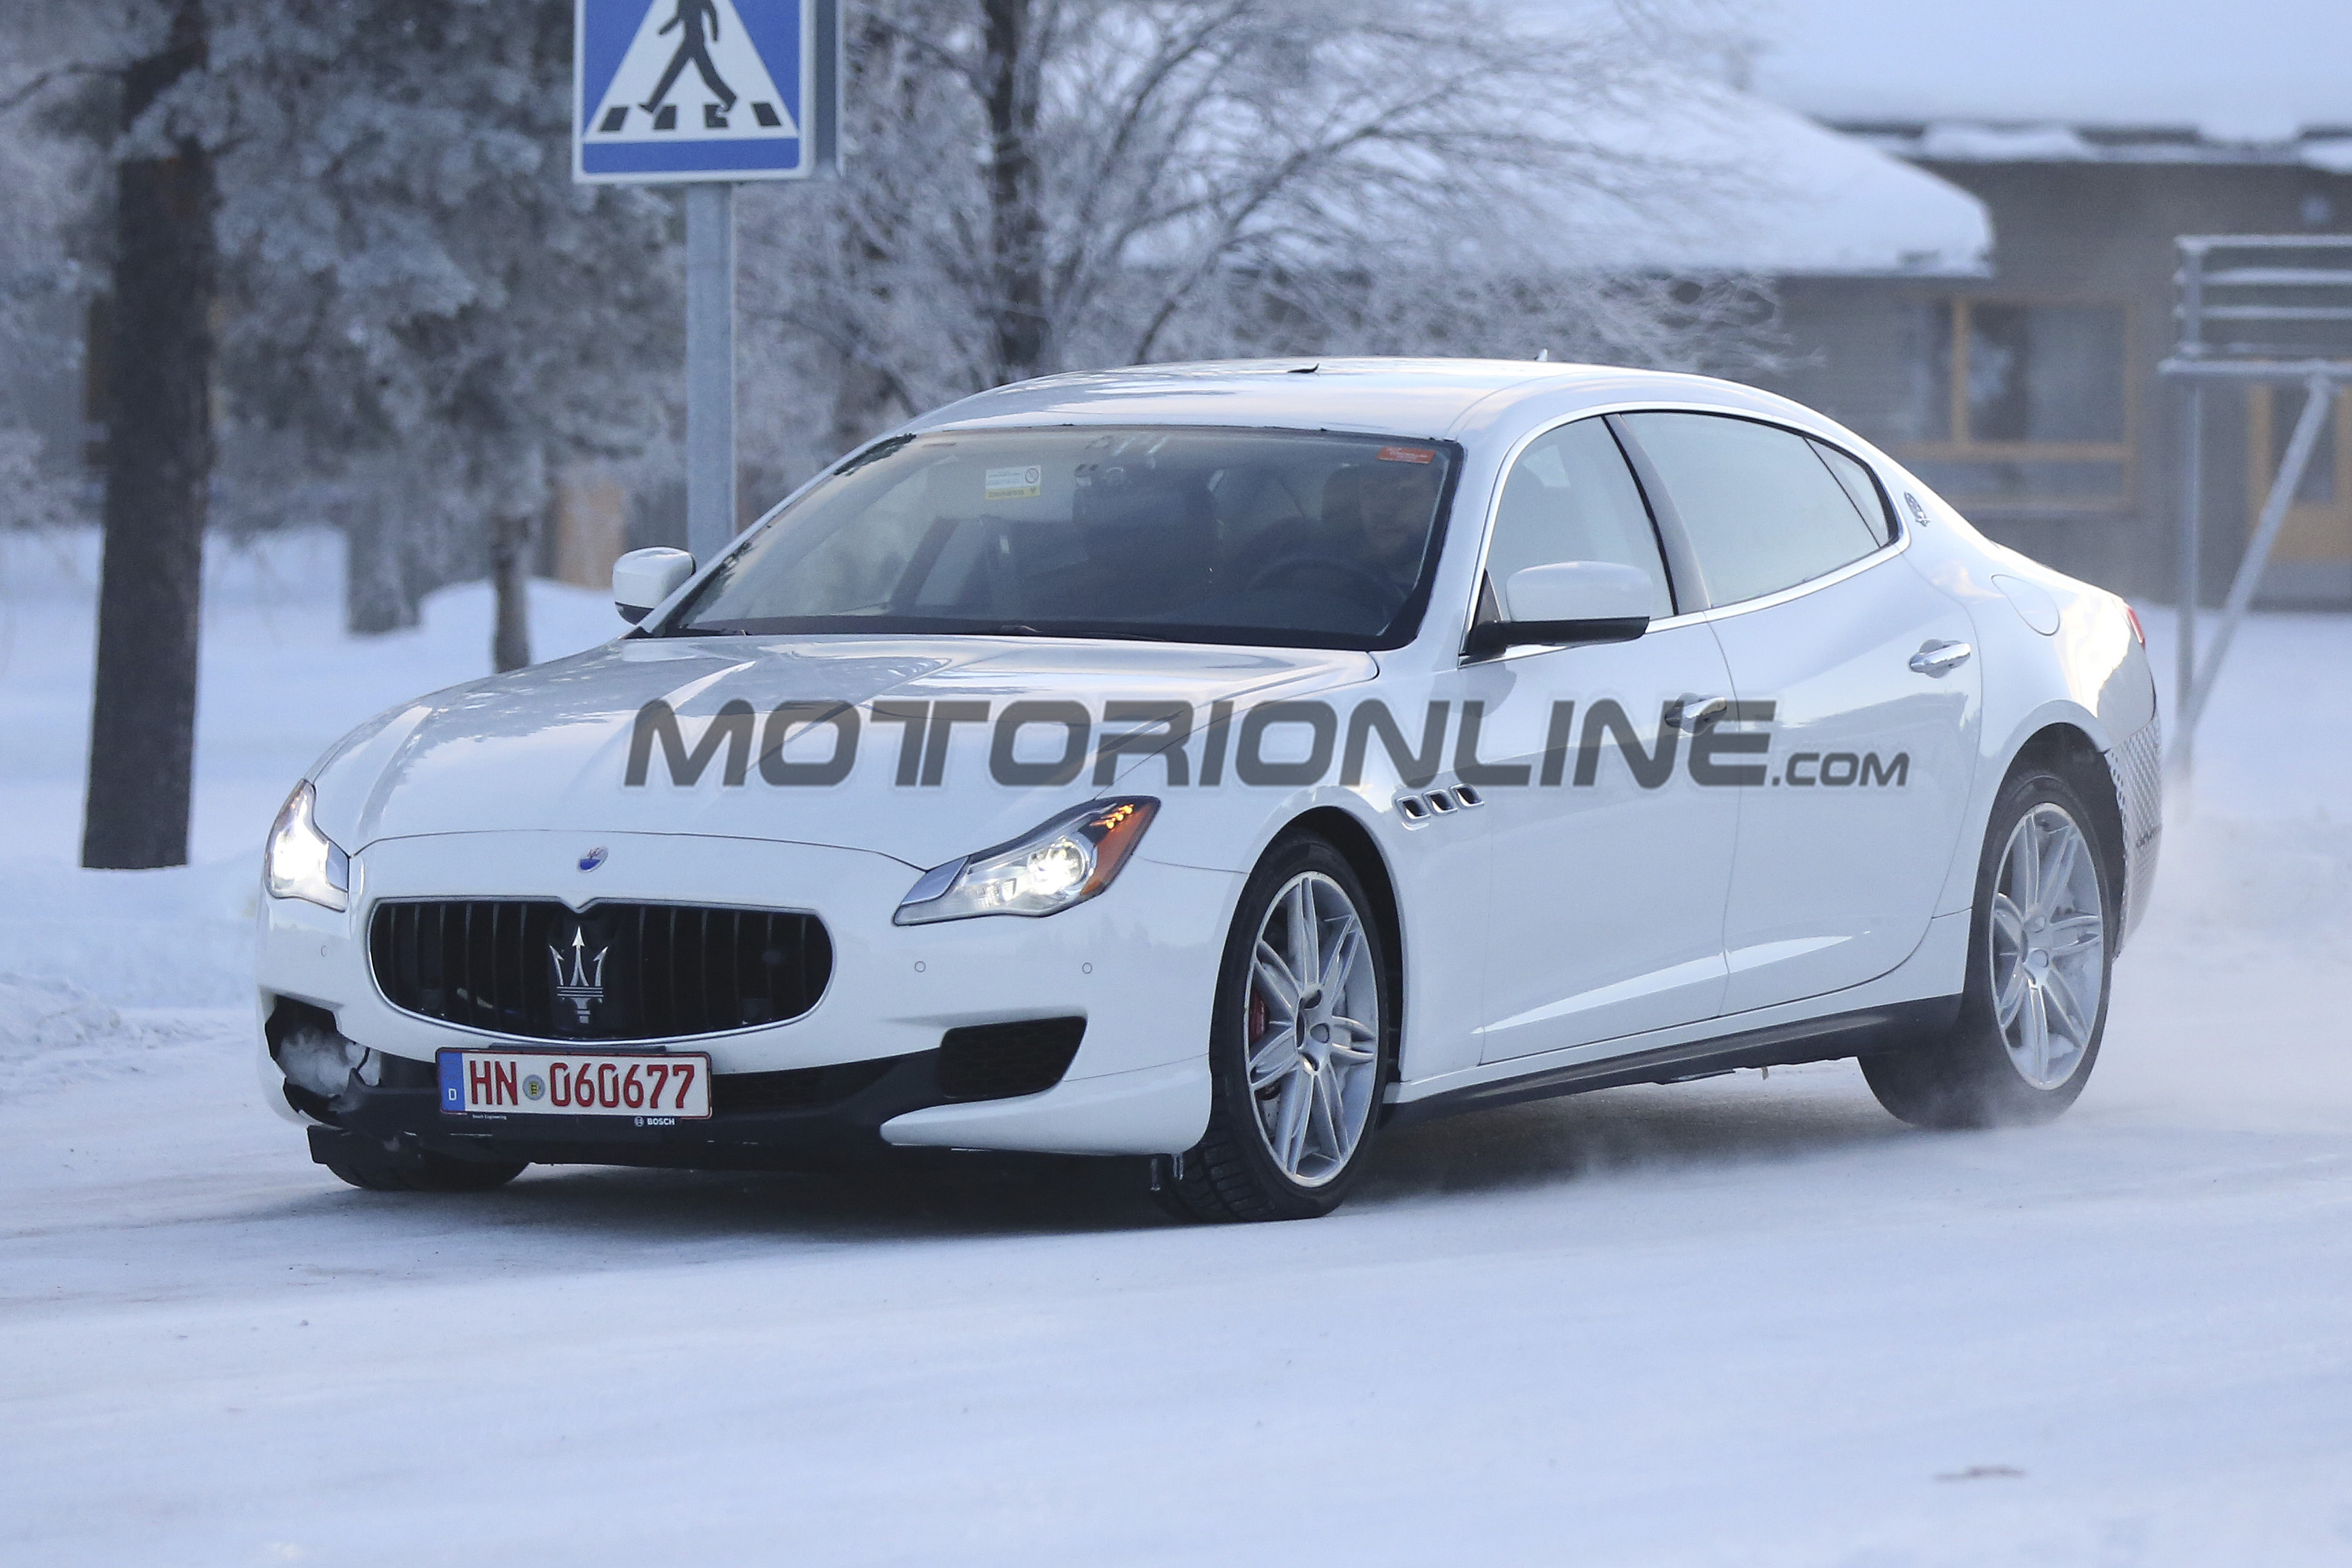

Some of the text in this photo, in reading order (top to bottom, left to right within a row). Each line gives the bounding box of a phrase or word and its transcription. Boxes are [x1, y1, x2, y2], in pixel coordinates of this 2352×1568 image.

[470, 1059, 695, 1109] HN 060677
[448, 1088, 457, 1101] D
[646, 1117, 676, 1126] BOSCH
